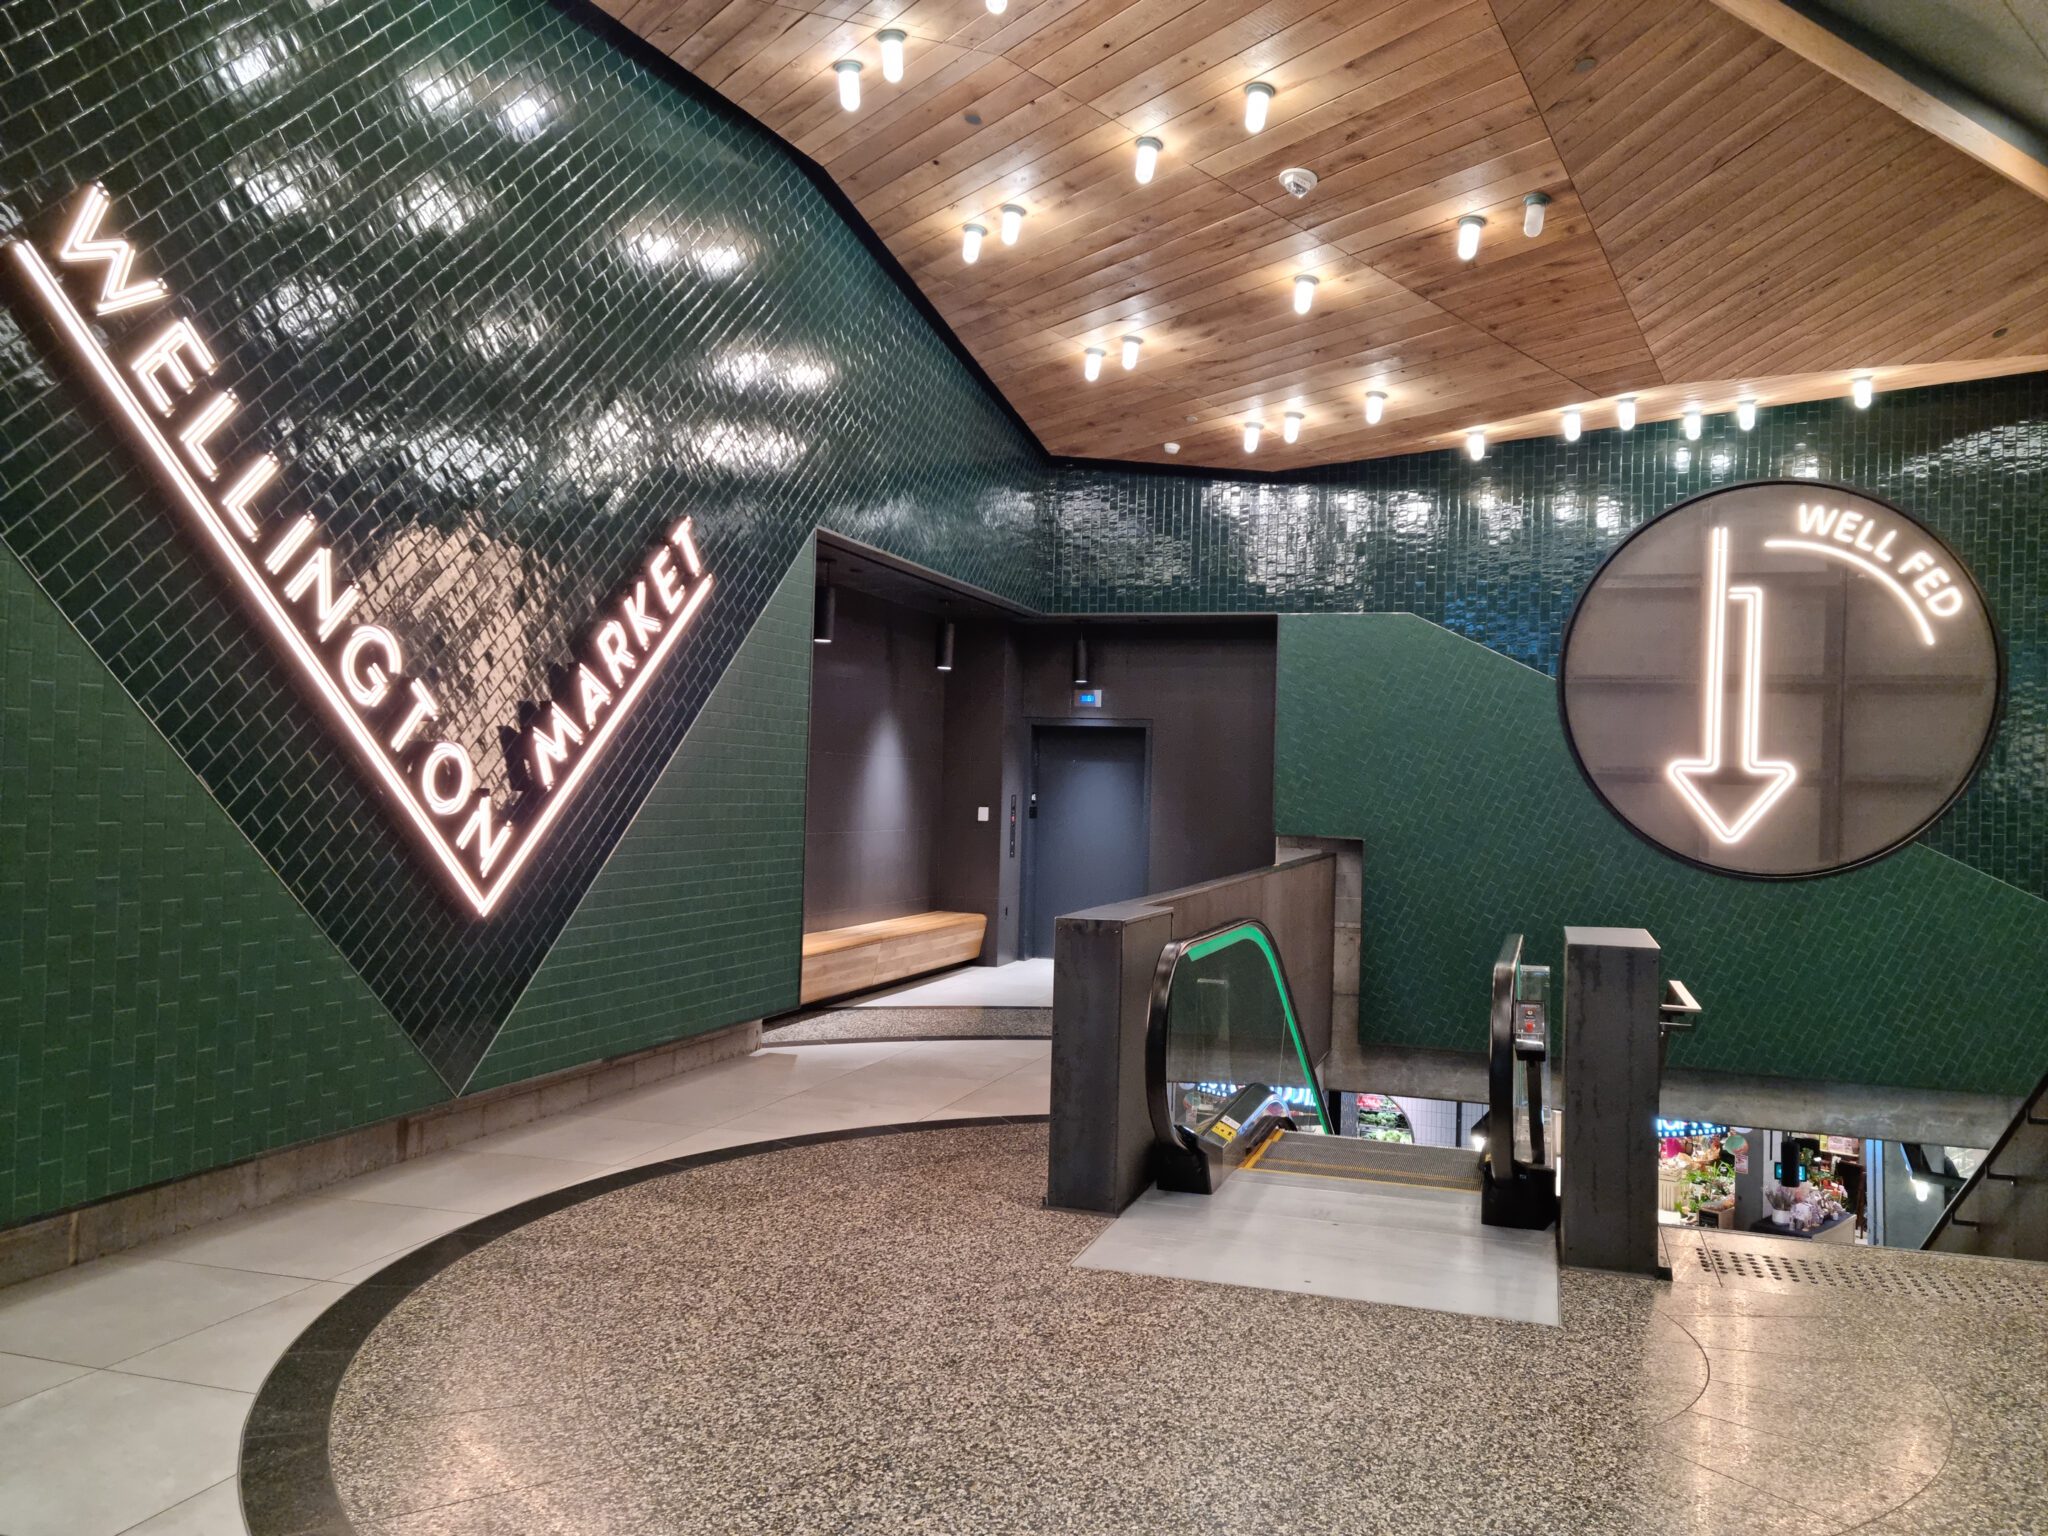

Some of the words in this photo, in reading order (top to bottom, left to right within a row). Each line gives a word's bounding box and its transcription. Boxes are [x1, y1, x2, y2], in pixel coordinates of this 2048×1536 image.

[60, 180, 513, 878] WELLINGTON
[531, 515, 701, 791] MARKET
[1798, 503, 1897, 563] WELL
[1897, 549, 1964, 617] FED
